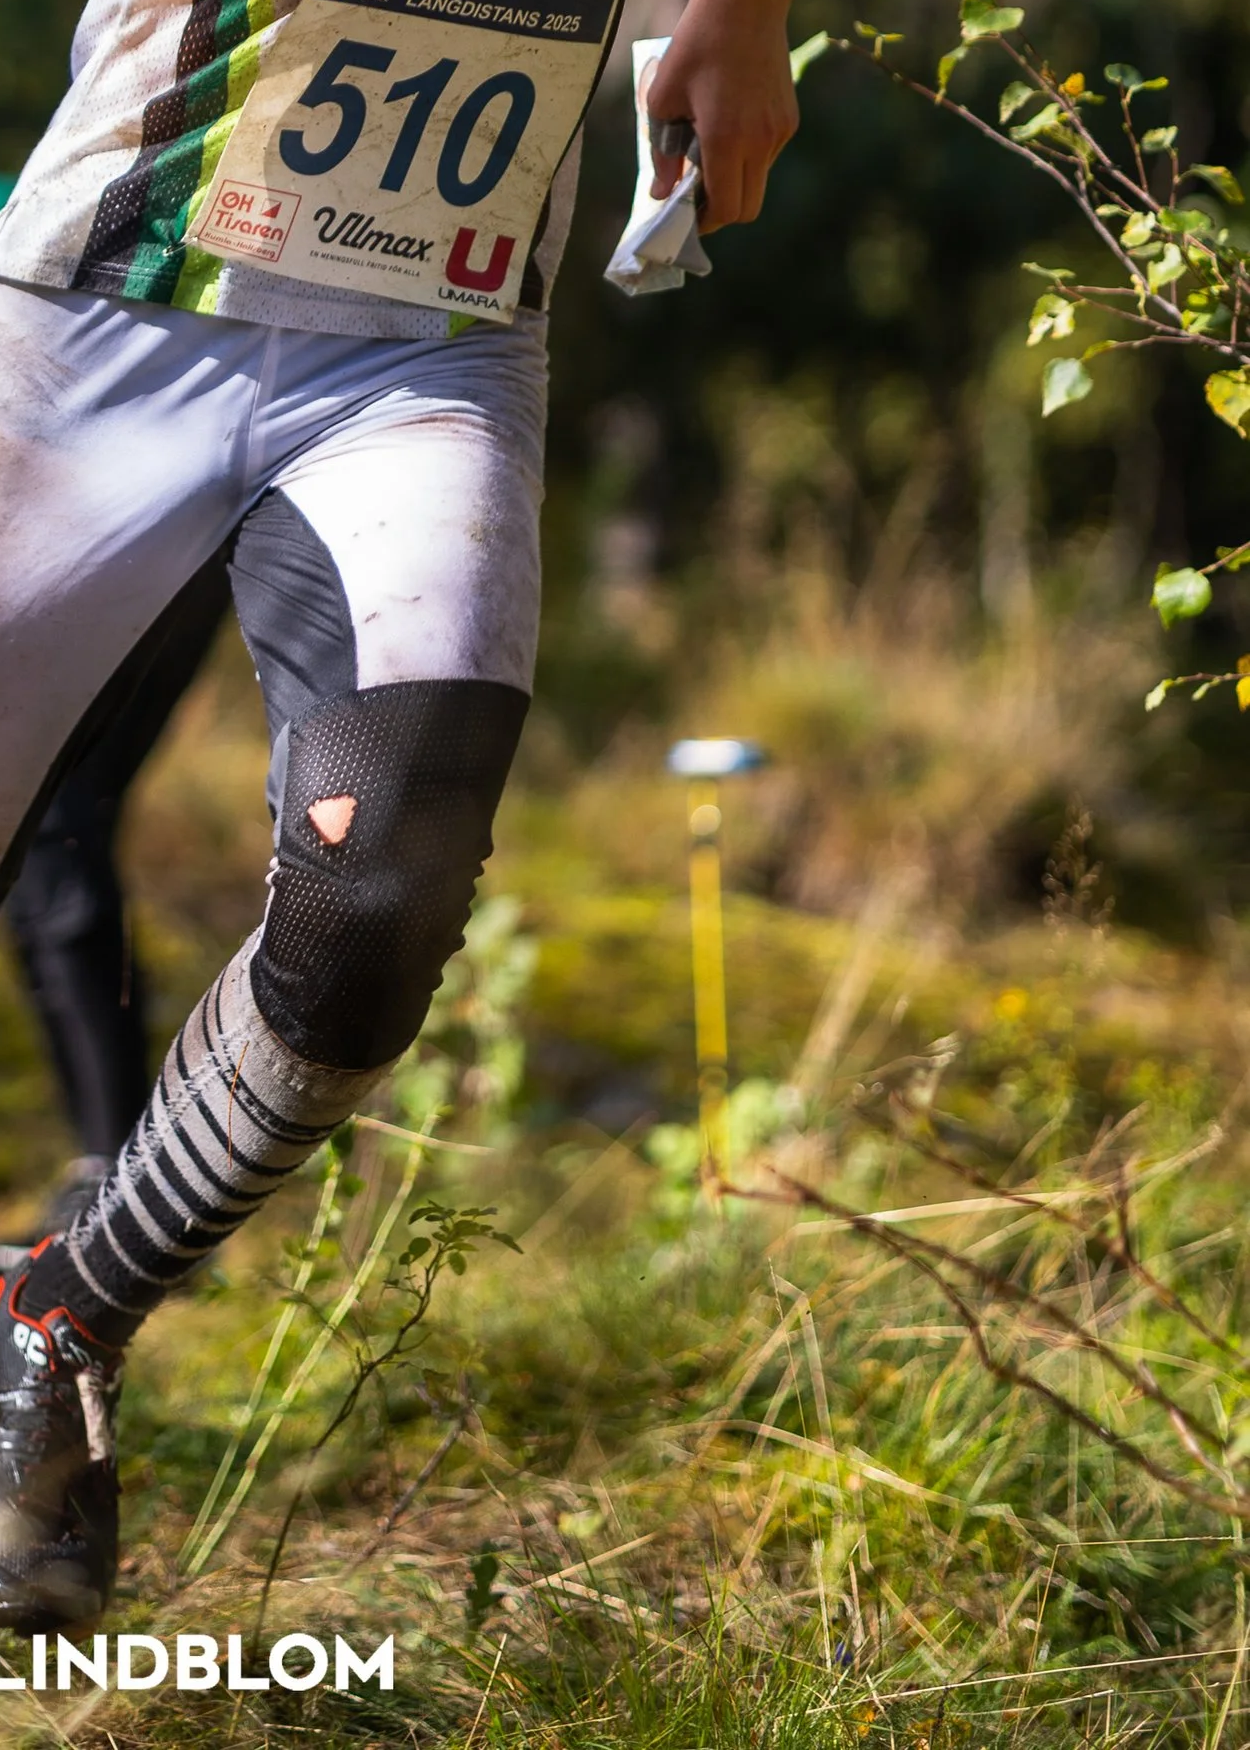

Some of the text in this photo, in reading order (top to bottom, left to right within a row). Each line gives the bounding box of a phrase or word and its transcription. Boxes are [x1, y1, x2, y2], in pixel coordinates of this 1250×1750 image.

[542, 13, 582, 33] 2025
[279, 39, 536, 207] 510
[215, 210, 283, 241] Tisaren
[313, 206, 434, 261] Ullmax
[438, 286, 500, 311] UMARA
